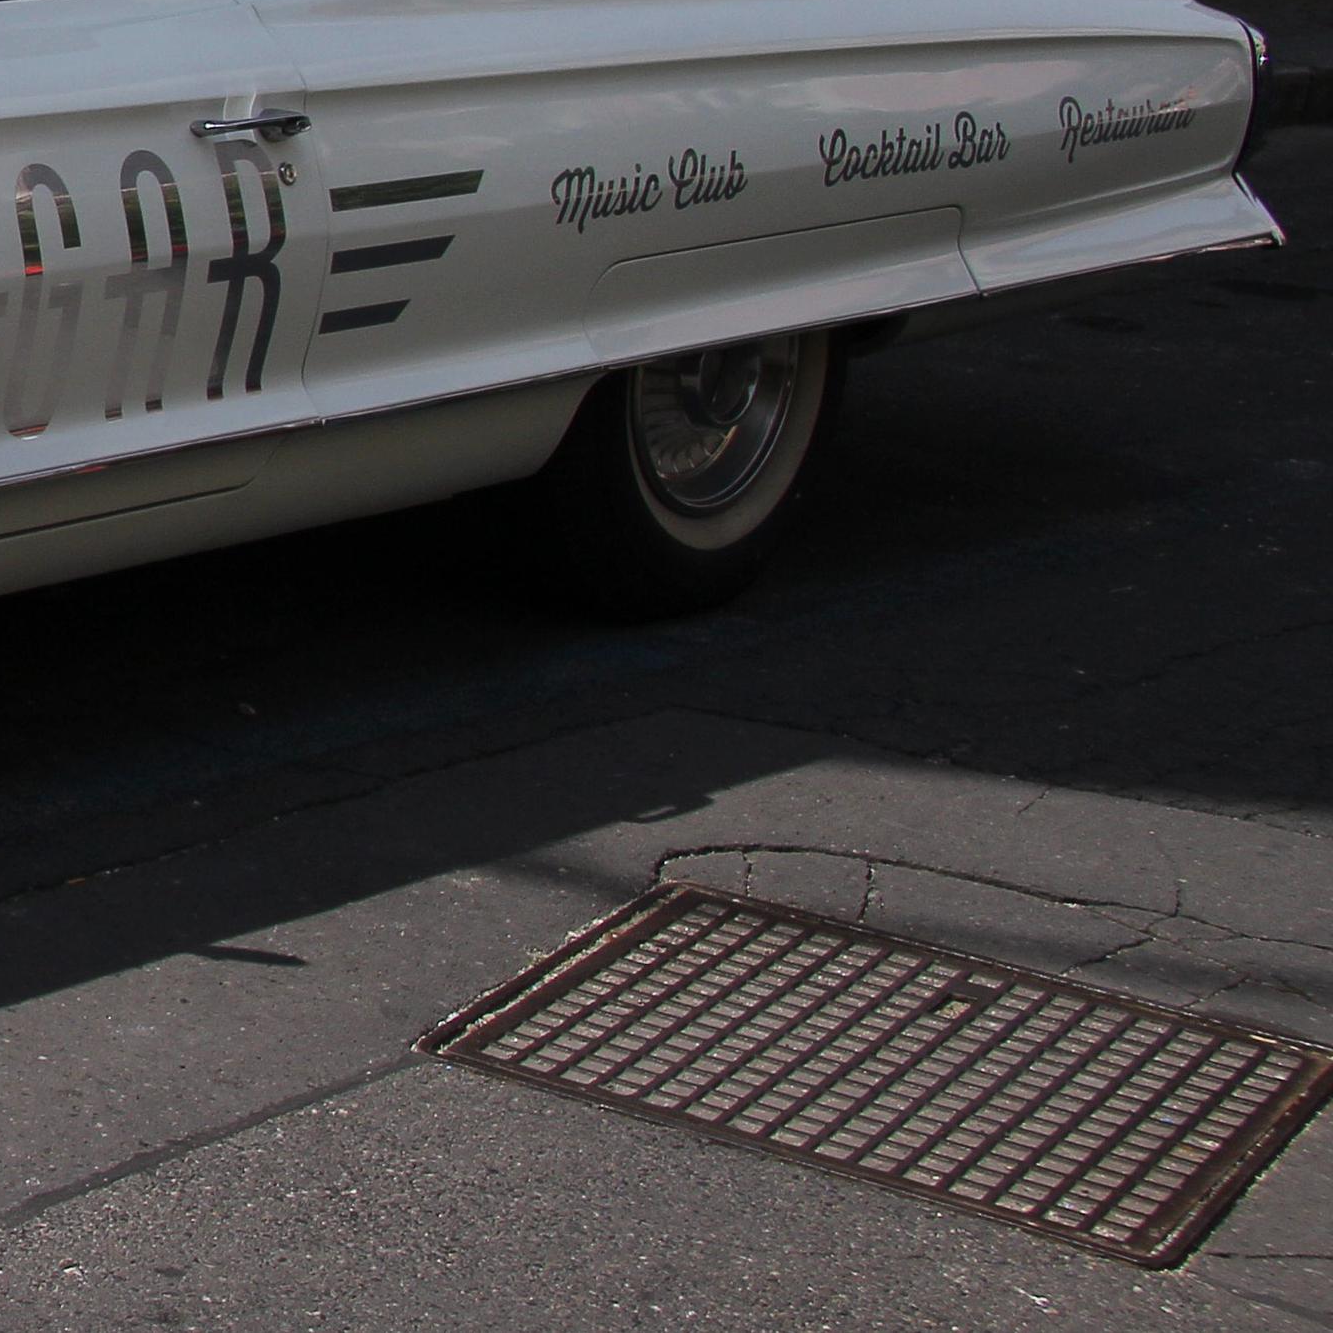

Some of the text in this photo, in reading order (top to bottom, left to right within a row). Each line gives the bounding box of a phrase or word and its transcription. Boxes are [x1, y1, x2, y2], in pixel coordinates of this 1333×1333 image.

[819, 111, 1010, 187] Cocktail Bar
[1059, 96, 1195, 163] Restaurant
[551, 148, 748, 234] Music Club
